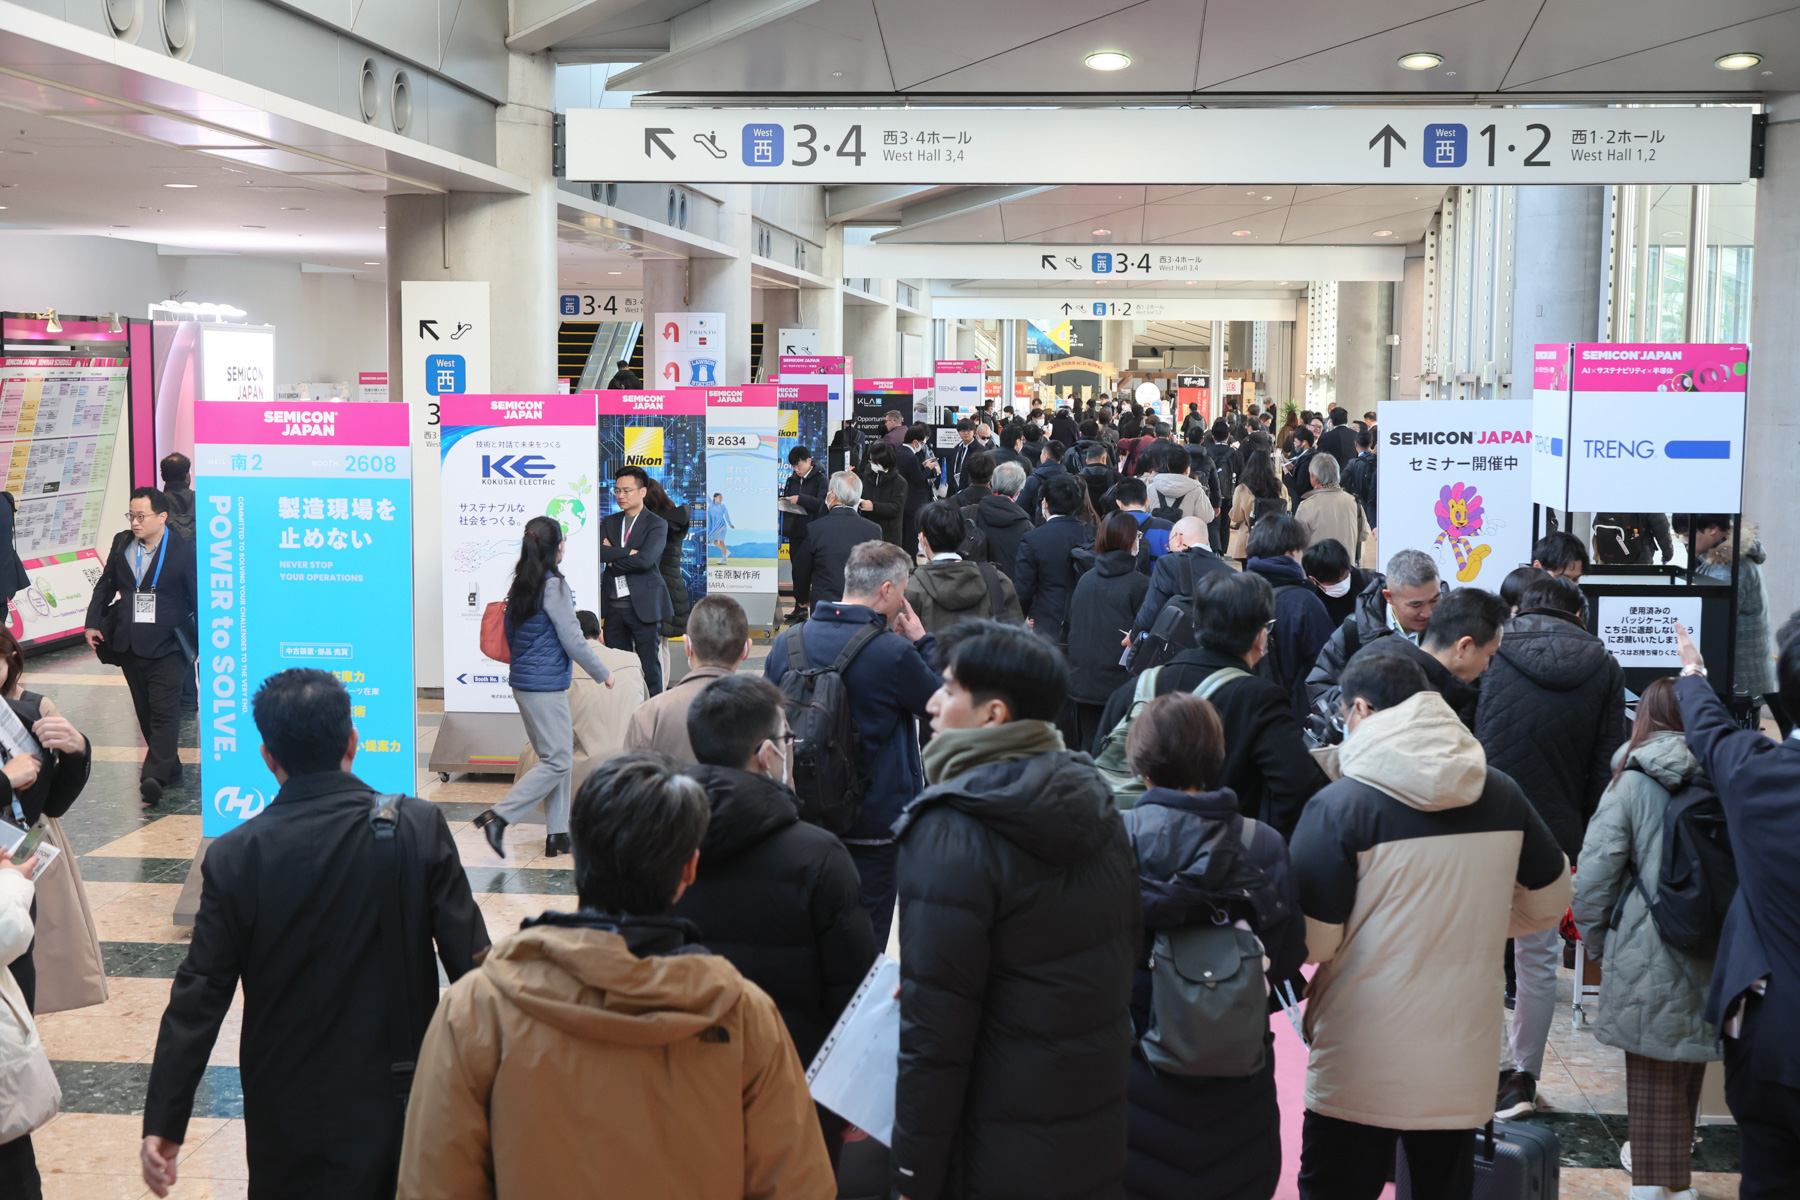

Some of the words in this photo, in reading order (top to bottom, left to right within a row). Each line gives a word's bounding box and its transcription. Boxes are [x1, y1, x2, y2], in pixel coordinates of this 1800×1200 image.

[753, 128, 773, 137] West
[1435, 129, 1456, 137] West
[754, 140, 772, 163] 西
[883, 149, 913, 162] West
[917, 149, 940, 162] Hall
[945, 149, 964, 163] 3,4
[1435, 140, 1455, 164] 西
[1571, 148, 1602, 161] West
[1606, 148, 1632, 161] Hall
[1636, 149, 1656, 163] 1,2
[1098, 260, 1107, 271] 西
[1582, 351, 1639, 360] SEMICON
[1640, 351, 1682, 360] JAPAN
[437, 359, 455, 367] West
[227, 366, 263, 381] SEMICON
[437, 370, 454, 392] 西
[238, 385, 263, 400] JAPAN
[491, 401, 542, 410] SEMICON
[264, 411, 335, 423] SEMICON
[504, 411, 542, 419] JAPAN
[281, 424, 334, 436] JAPAN
[718, 436, 746, 445] 2634
[1389, 431, 1473, 445] SEMICON
[1583, 440, 1655, 458] TRENG
[345, 455, 396, 472] 2608
[626, 455, 662, 466] Nikon
[1409, 455, 1518, 471] セミナー開催中
[278, 497, 396, 520] 製造現場を
[459, 503, 525, 512] サステナブルな
[459, 516, 521, 526] 社会をつくる。
[279, 527, 372, 550] 止めない
[239, 540, 245, 551] TO
[209, 495, 234, 610] POWER
[306, 574, 363, 582] OPERATIONS
[212, 616, 234, 649] to
[241, 653, 247, 663] TO
[212, 656, 236, 761] SOLVE.
